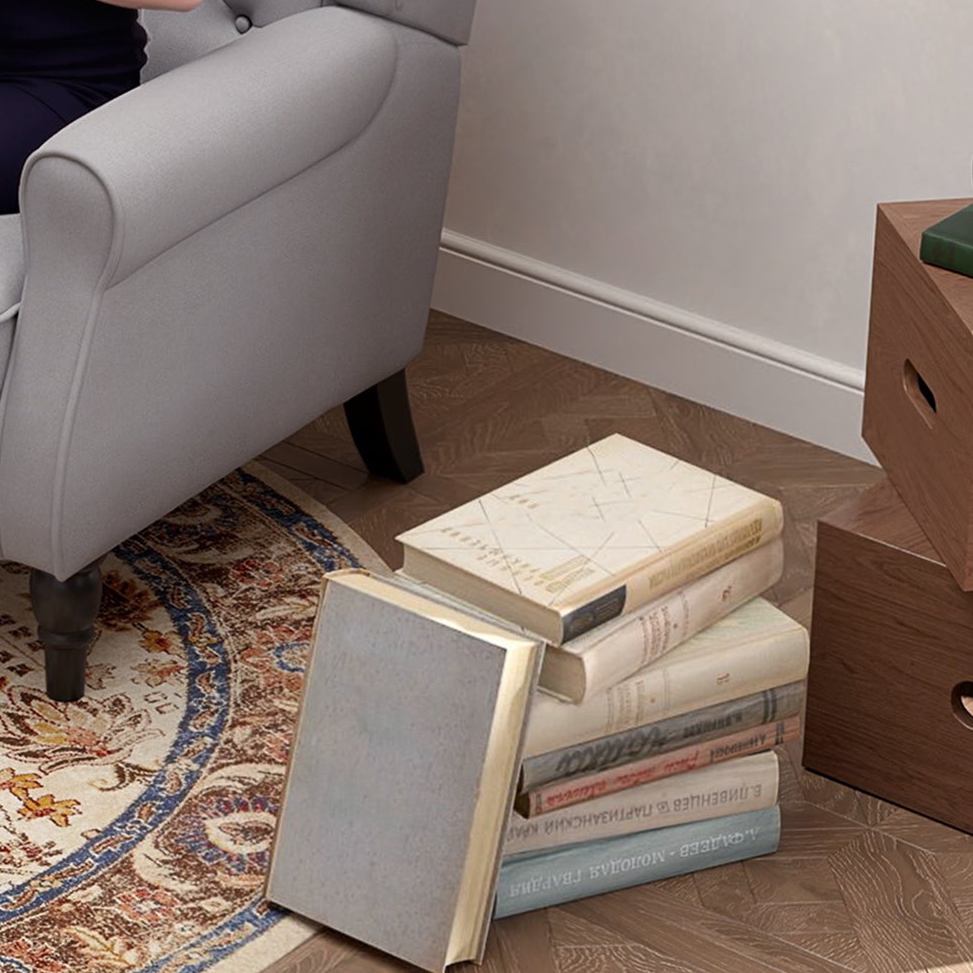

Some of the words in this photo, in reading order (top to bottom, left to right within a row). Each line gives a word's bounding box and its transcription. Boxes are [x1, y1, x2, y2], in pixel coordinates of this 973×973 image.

[545, 803, 654, 836] ПАРТИЗАНСКИЙ
[589, 849, 666, 880] МОЛОДАЯ
[509, 870, 582, 898] ГВАРДИЯ
